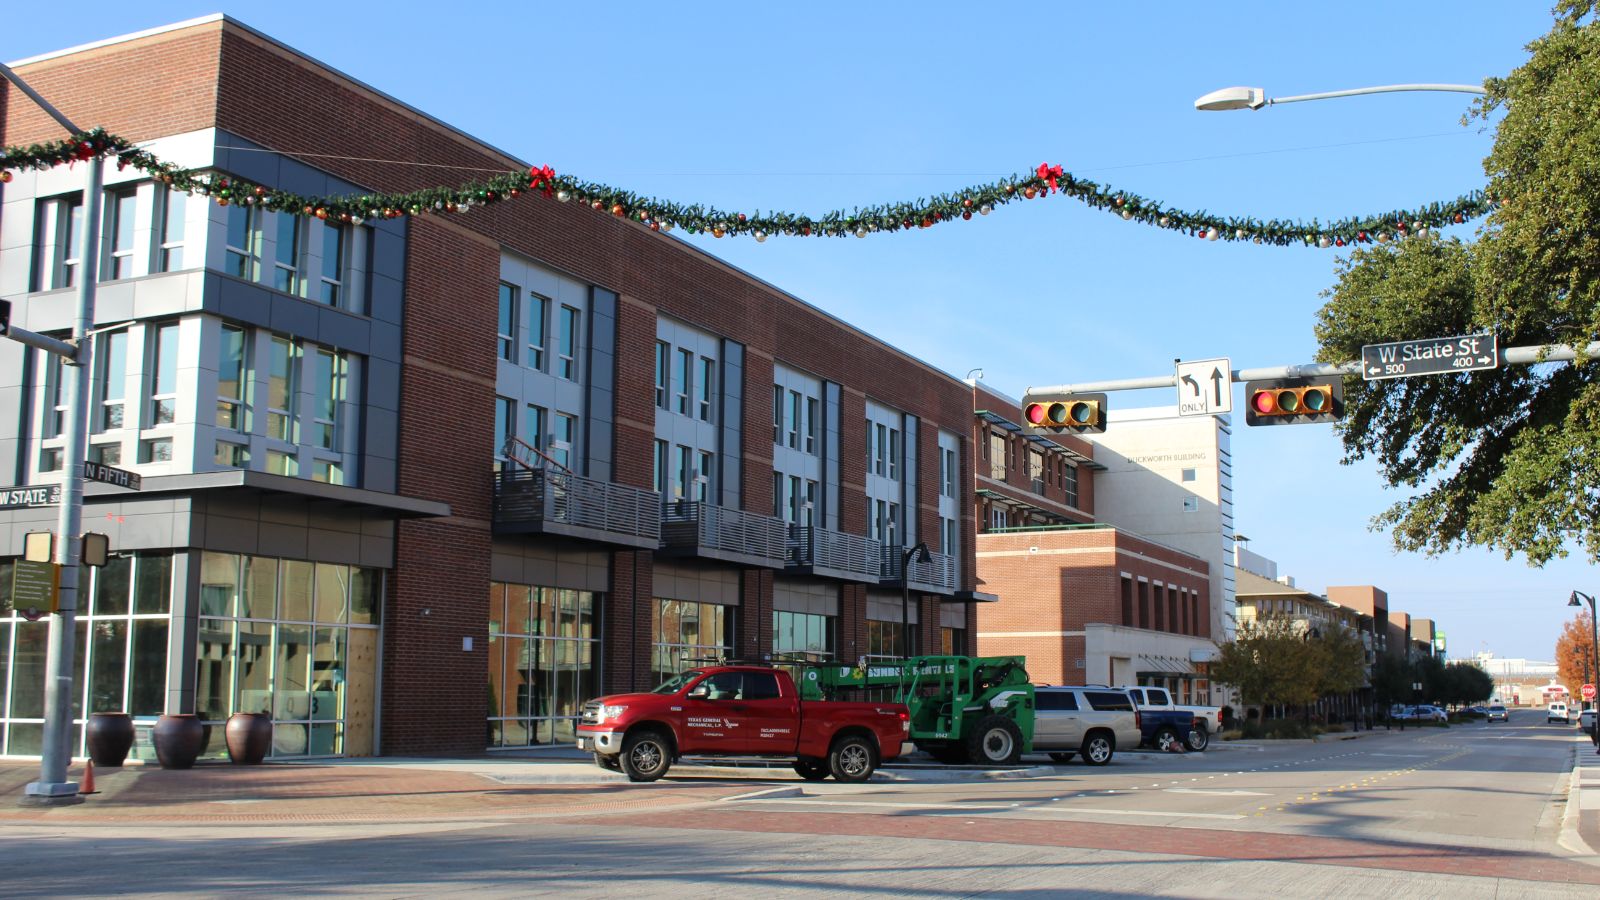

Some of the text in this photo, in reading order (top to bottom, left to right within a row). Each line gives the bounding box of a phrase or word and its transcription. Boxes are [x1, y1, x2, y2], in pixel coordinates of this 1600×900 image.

[1379, 338, 1479, 363] W State St
[1452, 357, 1473, 368] 400
[1385, 363, 1405, 374] 500
[1181, 402, 1204, 412] ONLY
[1127, 453, 1206, 464] DUCKWORTH BUILDING
[86, 464, 128, 485] N FIFTH
[0, 488, 47, 505] W STATE
